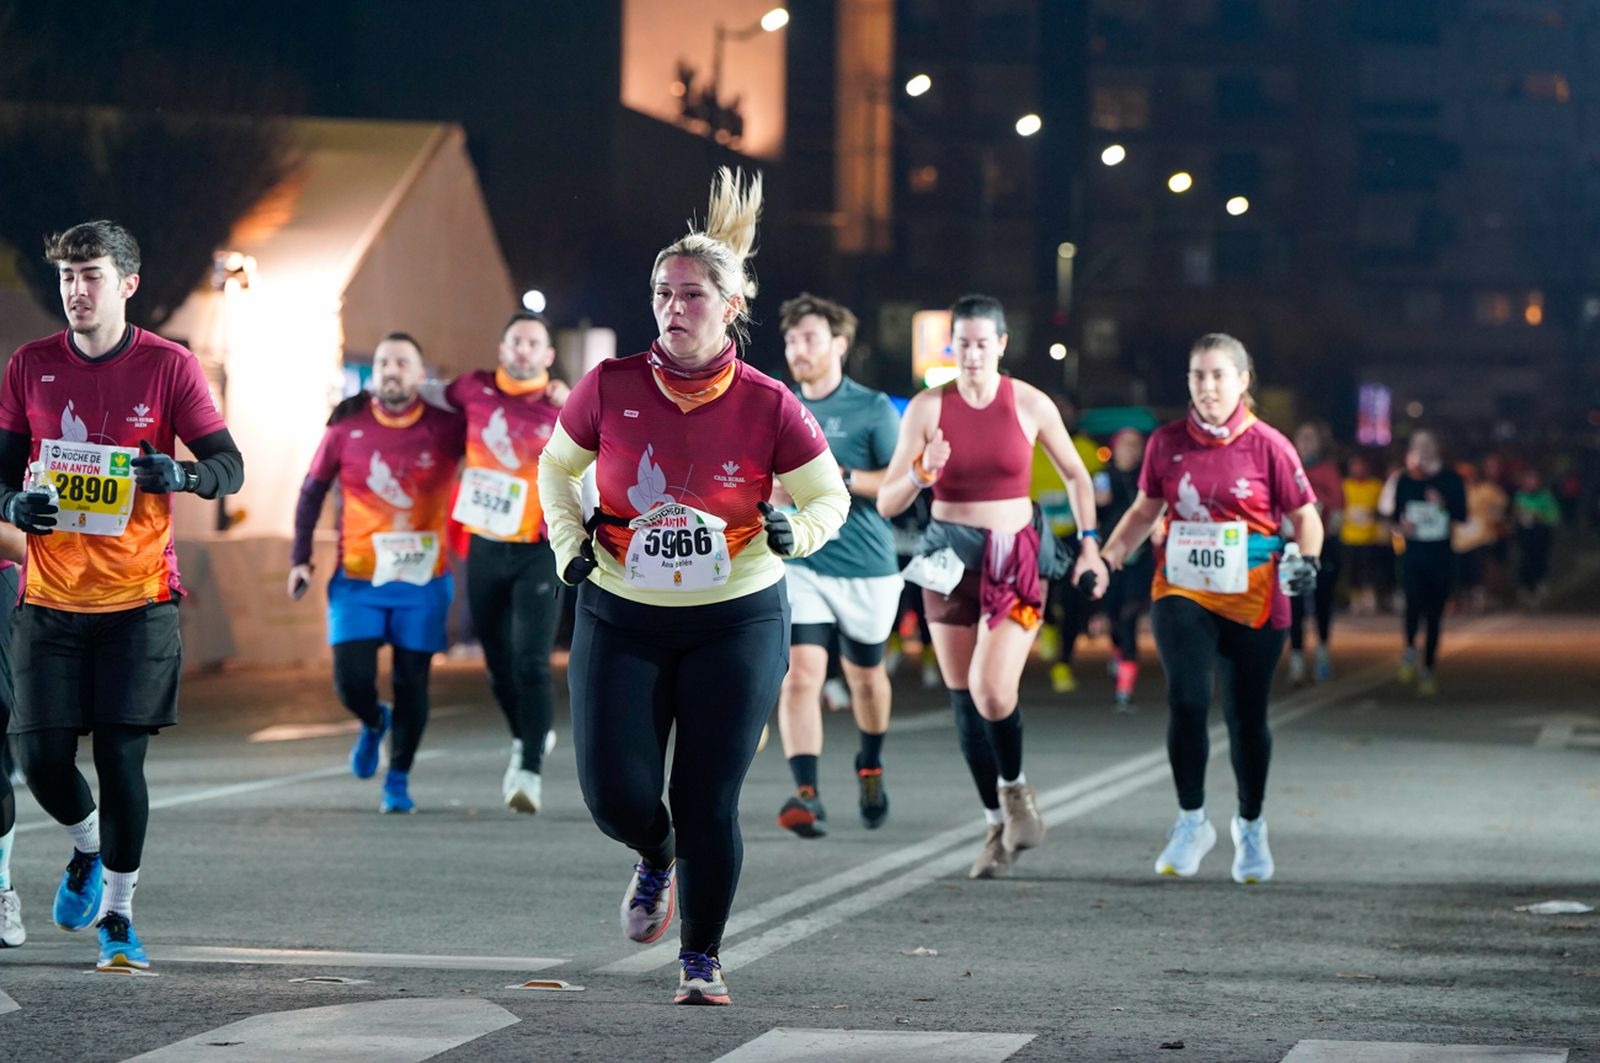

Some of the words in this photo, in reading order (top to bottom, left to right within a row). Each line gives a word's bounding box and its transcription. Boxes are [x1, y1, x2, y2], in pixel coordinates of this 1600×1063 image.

[62, 452, 89, 462] NOCHE
[90, 454, 102, 464] DE
[50, 461, 68, 471] SAN
[69, 463, 101, 475] ANTÓN
[55, 473, 118, 504] 2890
[674, 506, 687, 515] DE
[644, 527, 712, 559] 5966
[661, 560, 674, 568] Ana
[1188, 548, 1225, 568] 406
